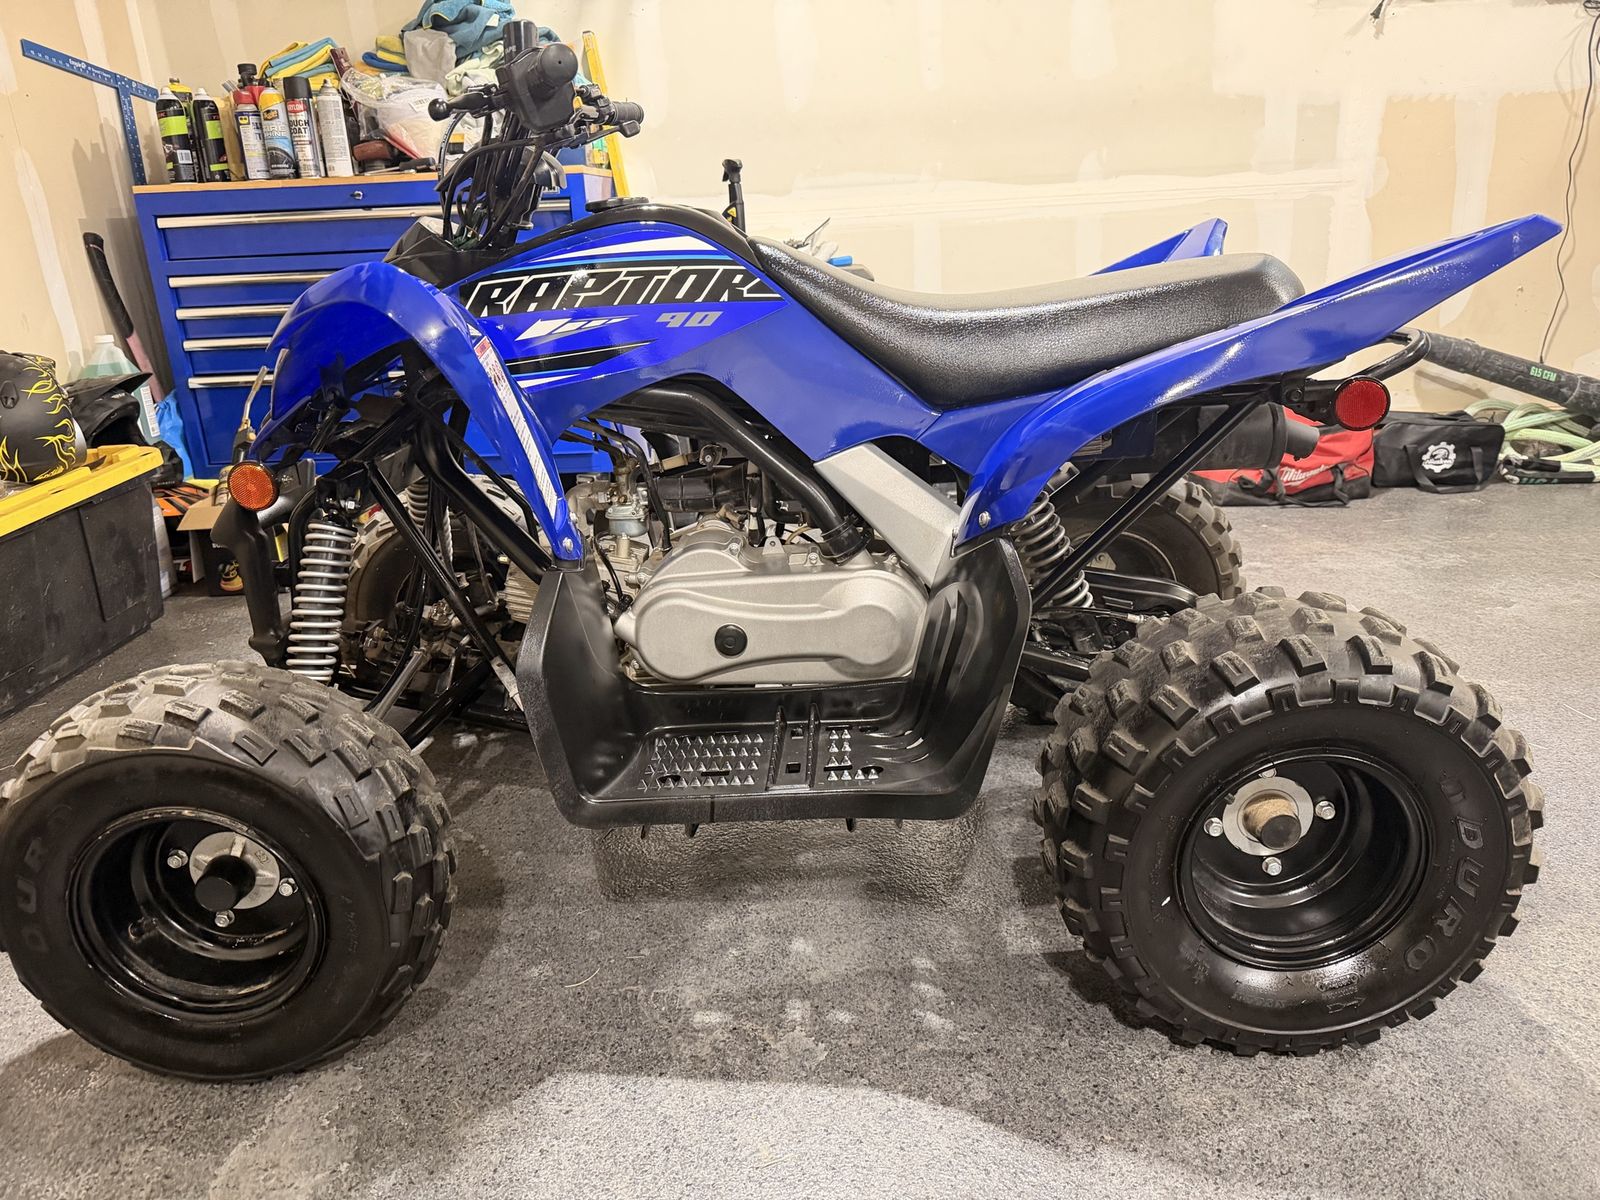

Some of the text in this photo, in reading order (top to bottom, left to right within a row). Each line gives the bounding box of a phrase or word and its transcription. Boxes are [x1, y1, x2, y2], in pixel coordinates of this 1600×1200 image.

[289, 119, 309, 127] OUGH
[465, 265, 783, 318] RAPTOR
[655, 311, 724, 328] 90
[1529, 366, 1557, 382] 615 CFM
[1403, 815, 1485, 970] DURO
